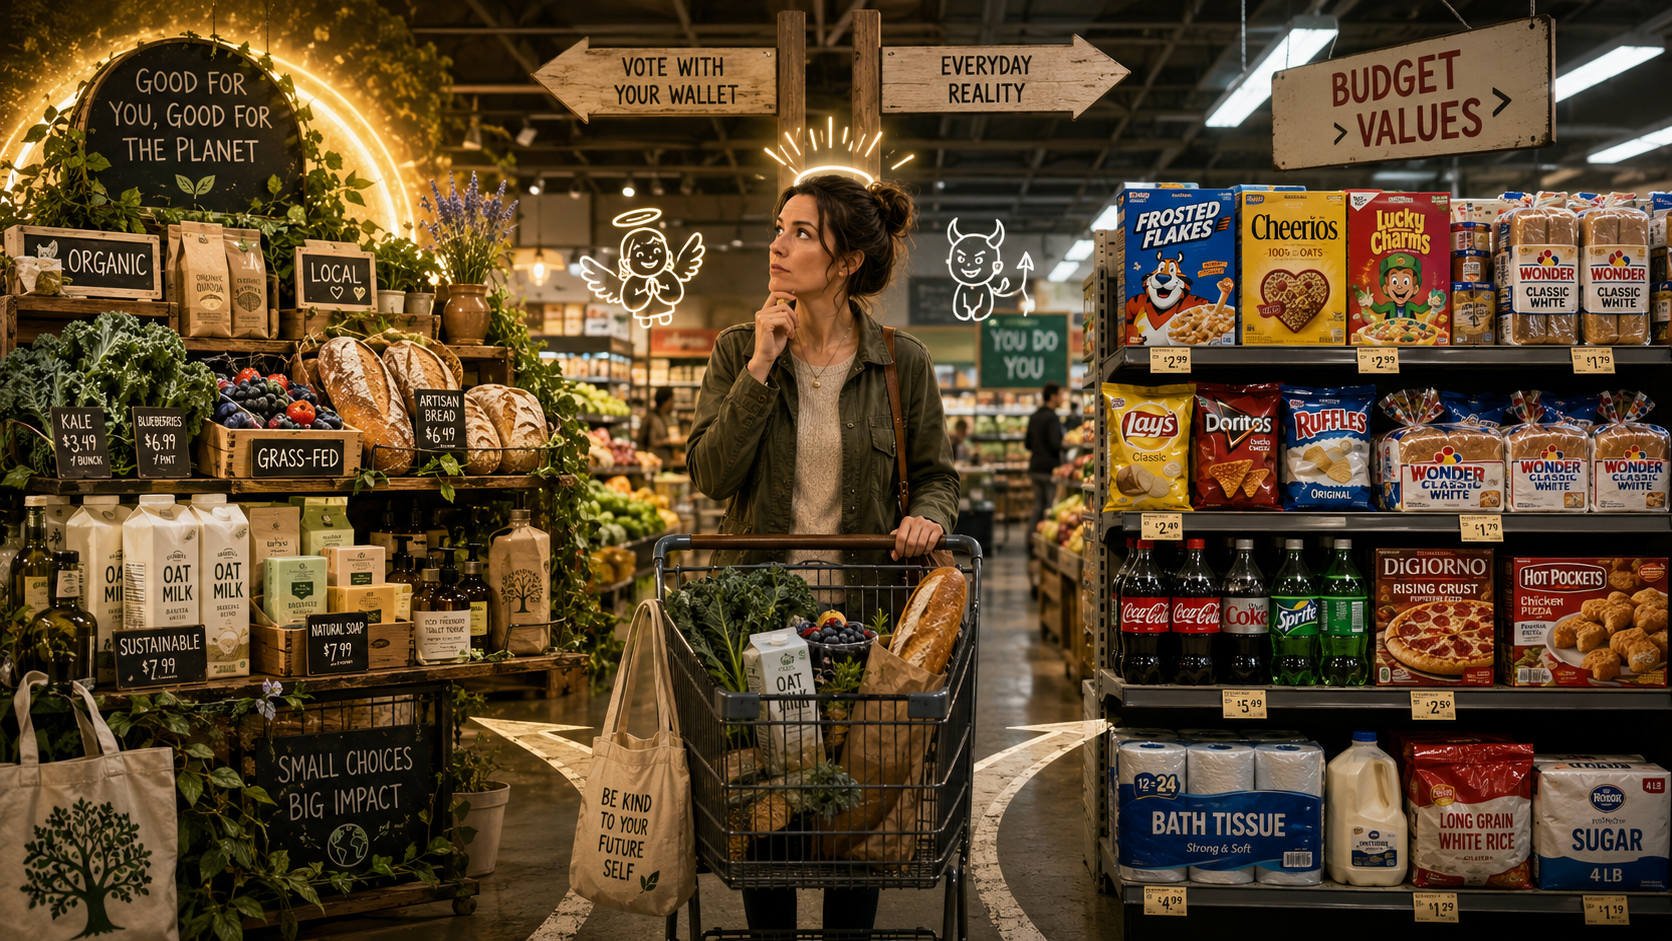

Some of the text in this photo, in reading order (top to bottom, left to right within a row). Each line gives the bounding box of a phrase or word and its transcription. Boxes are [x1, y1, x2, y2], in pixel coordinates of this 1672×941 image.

[622, 57, 724, 77] VOTE WITH
[941, 55, 1033, 76] EVERYDAY
[136, 68, 247, 96] GOOD FOR
[1332, 48, 1461, 107] BUDGET
[614, 84, 739, 105] YOUR WALLET
[948, 83, 1026, 104] REALITY
[109, 100, 273, 130] YOU, GOOD FOR
[1356, 97, 1483, 147] VALUES
[122, 137, 259, 163] THE PLANET
[1135, 201, 1221, 233] FROSTED
[1251, 214, 1338, 240] Cheerios
[1376, 208, 1425, 234] Lucky
[1142, 220, 1214, 249] FLAKES
[1370, 232, 1431, 255] Charms
[68, 248, 148, 276] ORGANIC
[1299, 248, 1323, 257] OATS
[311, 262, 362, 285] LOCAL
[1519, 267, 1575, 281] WONDER
[1590, 267, 1646, 281] WONDER
[1526, 287, 1570, 297] CLASSIC
[1597, 287, 1641, 297] CLASSIC
[1530, 298, 1566, 308] WHITE
[1601, 298, 1637, 308] WHITE
[990, 329, 1059, 352] YOU DO
[1003, 356, 1045, 380] YOU
[420, 395, 459, 408] ARTISAN
[61, 414, 93, 429] KALE
[425, 409, 456, 422] BREAD
[1205, 413, 1272, 433] Doritos
[1294, 409, 1367, 440] RUFFLES
[62, 434, 97, 453] $3.49
[144, 433, 176, 451] $6.99
[257, 447, 339, 472] GRASS-FED
[1132, 452, 1167, 462] Classic
[1410, 465, 1485, 482] WONDER
[1520, 461, 1581, 474] WONDER
[1604, 461, 1663, 474] WONDER
[1311, 489, 1352, 499] ORIGINAL
[1430, 490, 1470, 500] WHITE
[163, 564, 191, 583] OAT
[214, 562, 242, 581] OAT
[1383, 557, 1487, 576] DiGIORNO
[1524, 568, 1603, 586] HOT POCKETS
[163, 585, 193, 603] MILK
[213, 581, 243, 599] MILK
[1393, 583, 1478, 594] RISING CRUST
[1225, 605, 1268, 626] Coke
[1277, 606, 1317, 632] Sprite
[311, 621, 365, 637] NATURAL SOAP
[120, 633, 201, 656] SUSTAINABLE
[776, 673, 802, 692] OAT
[278, 746, 413, 783] SMALL CHOICES
[289, 783, 402, 821] BIG IMPACT
[601, 787, 652, 813] BE KIND
[601, 811, 648, 835] TO YOUR
[1152, 811, 1286, 837] BATH TISSUE
[1440, 812, 1514, 829] LONG GRAIN
[598, 834, 645, 859] FUTURE
[1186, 843, 1251, 855] Strong & Soft
[1438, 832, 1515, 850] WHITE RICE
[1572, 828, 1643, 851] SUGAR
[603, 859, 635, 881] SELF
[1590, 868, 1623, 882] 4 LB
